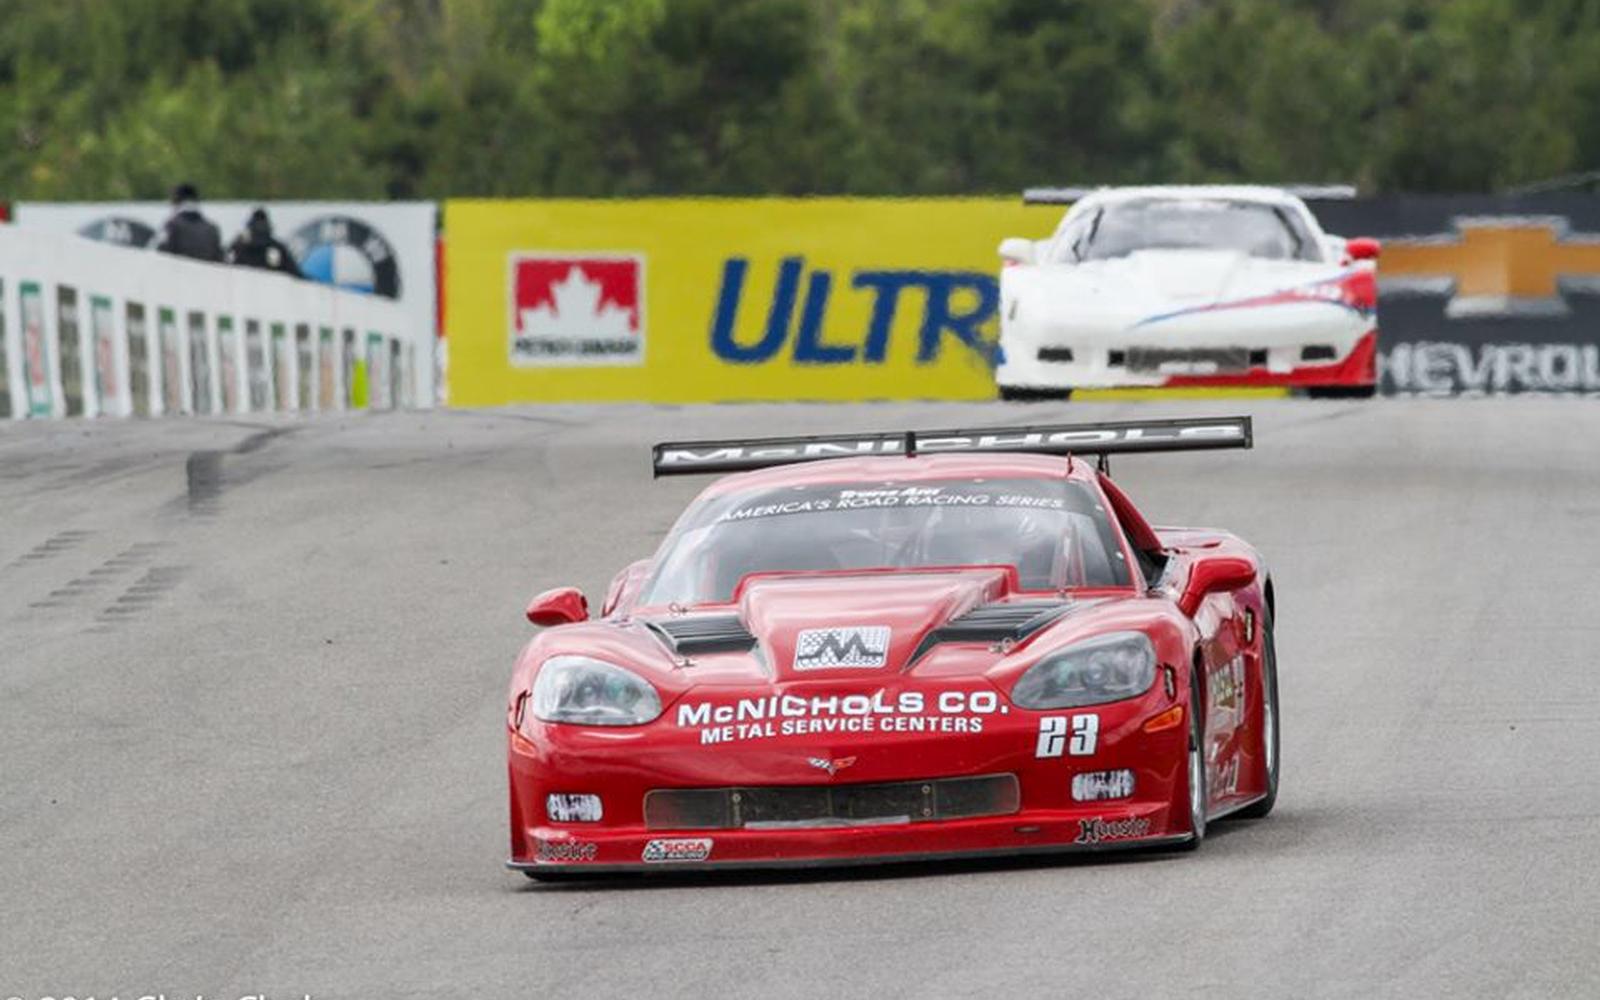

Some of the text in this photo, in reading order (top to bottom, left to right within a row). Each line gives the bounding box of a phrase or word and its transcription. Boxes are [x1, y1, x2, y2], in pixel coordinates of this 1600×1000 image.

[718, 494, 1063, 522] AMERICA'S ROAD RACING SERIES
[677, 691, 1009, 728] McNICHOLS CO.
[701, 716, 983, 745] METAL SERVICE CENTERS
[1036, 713, 1099, 758] 23
